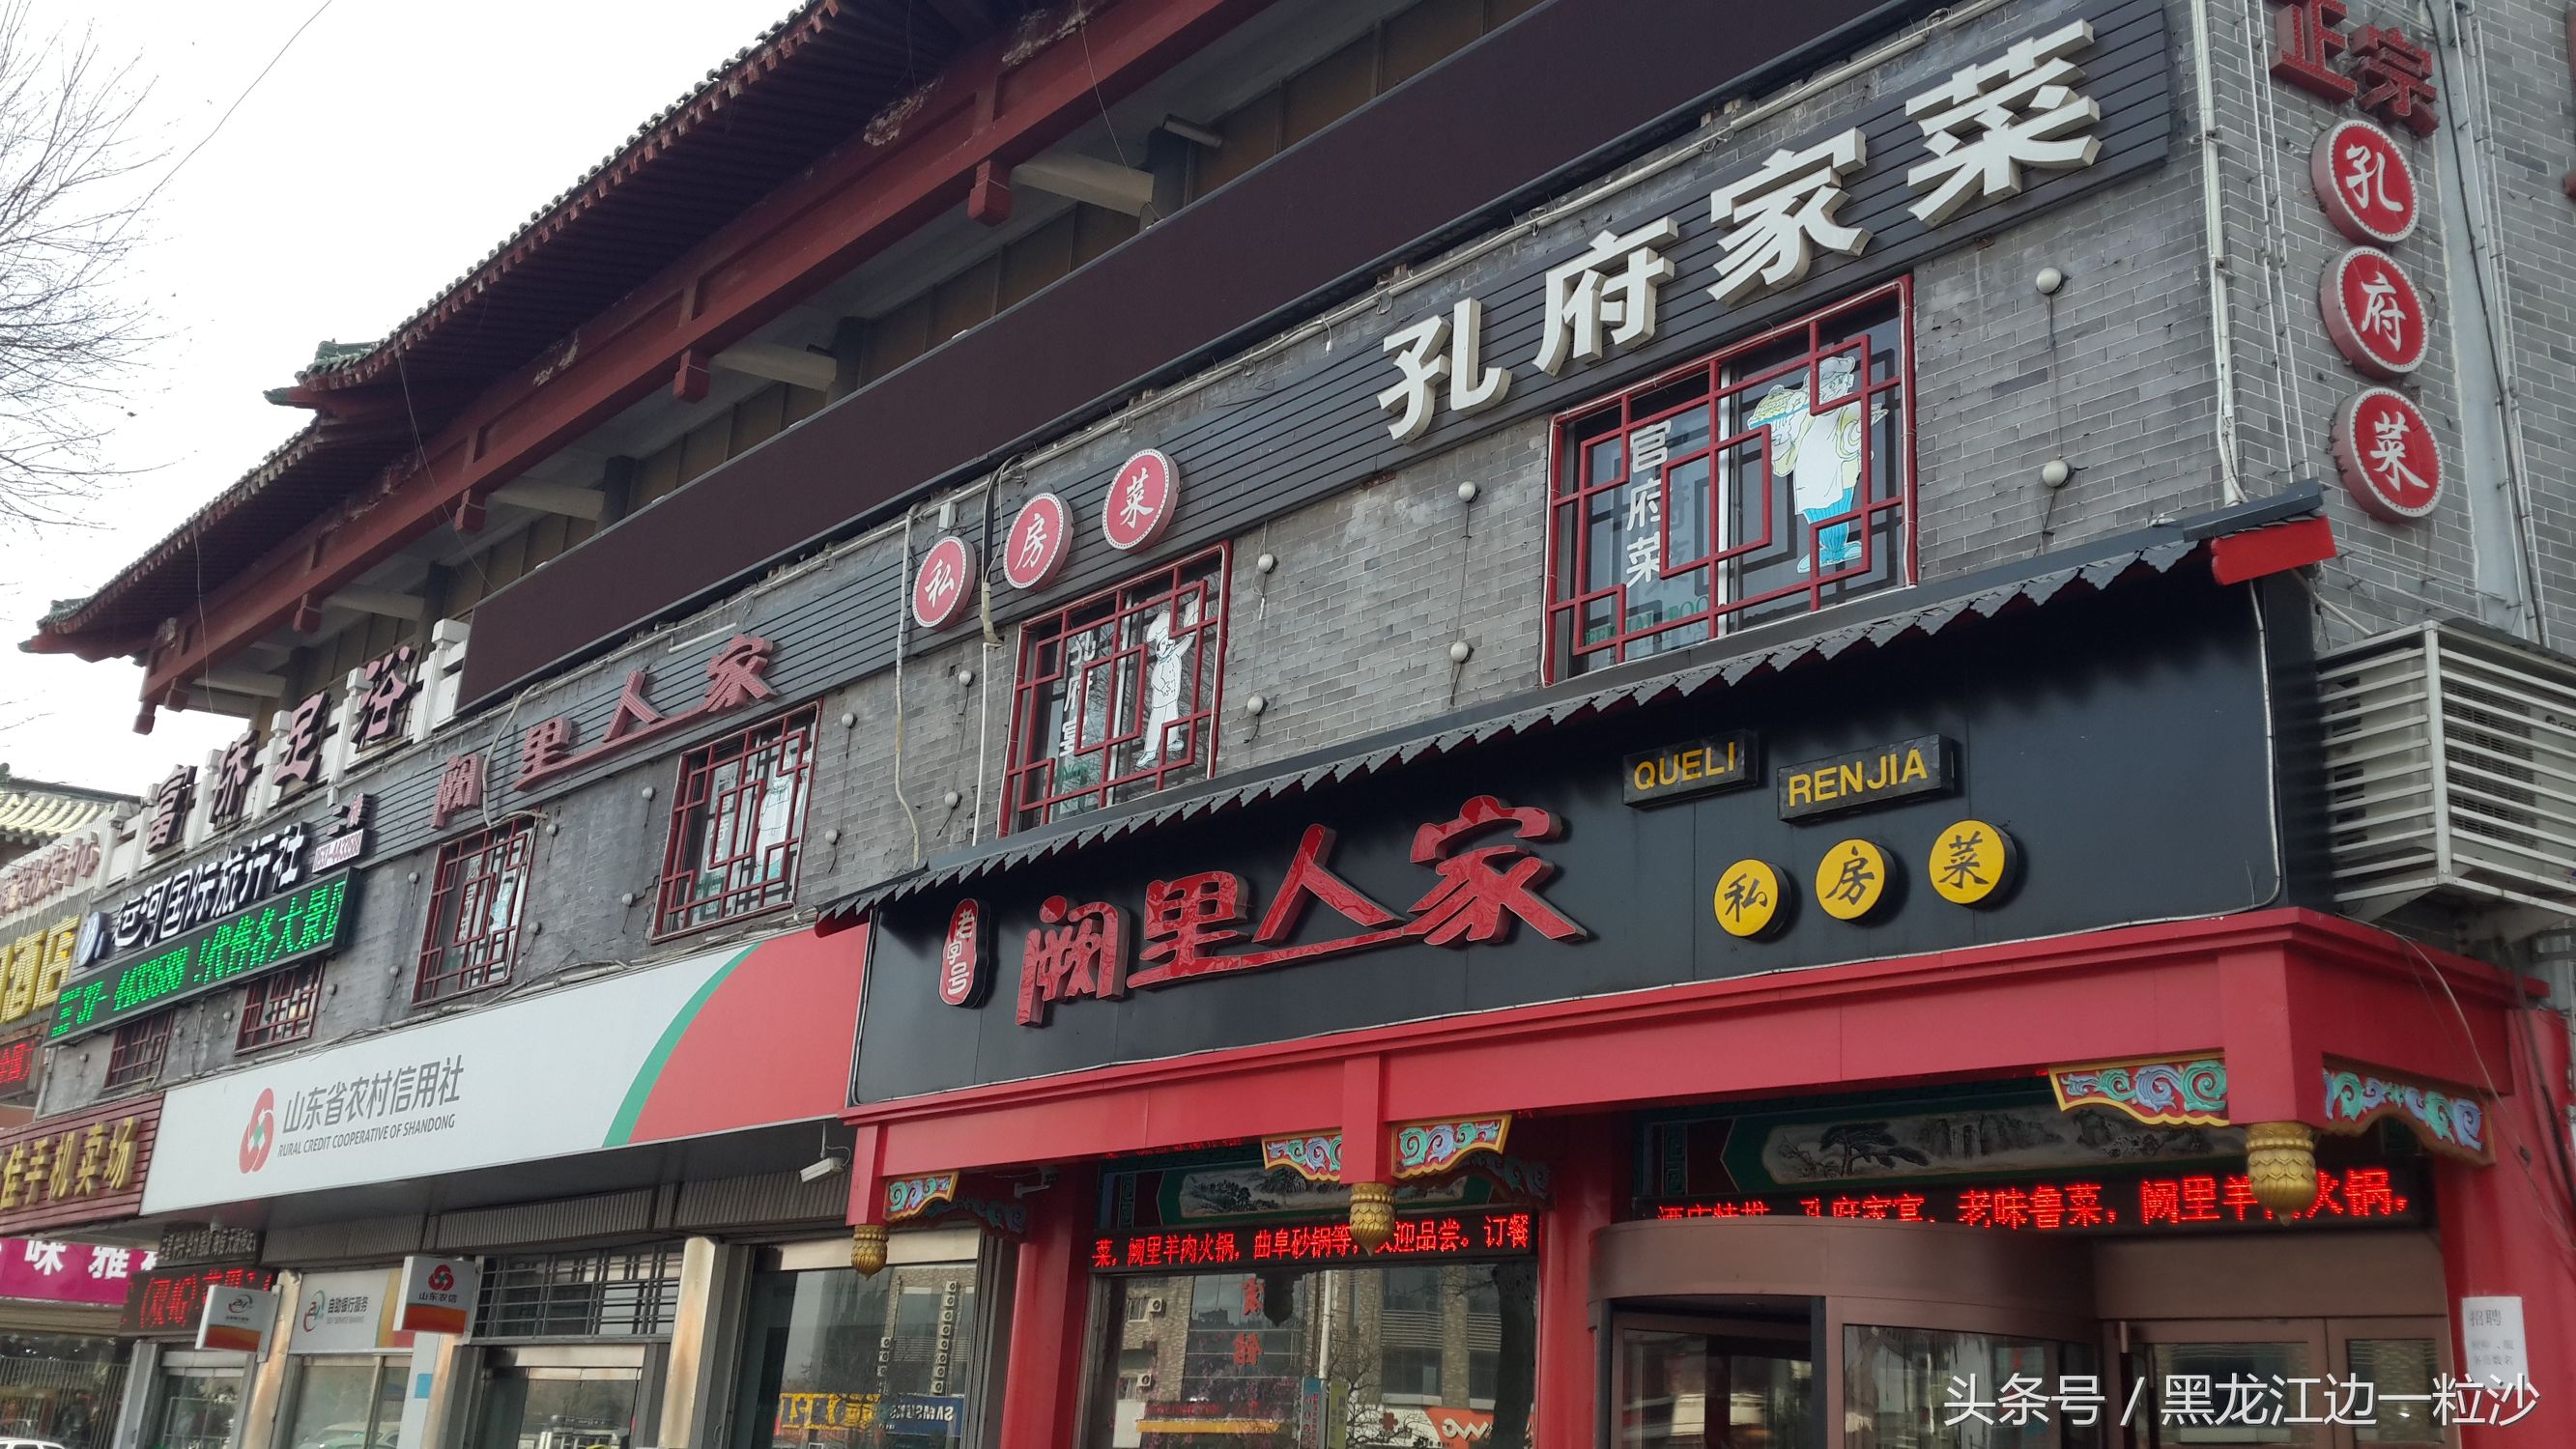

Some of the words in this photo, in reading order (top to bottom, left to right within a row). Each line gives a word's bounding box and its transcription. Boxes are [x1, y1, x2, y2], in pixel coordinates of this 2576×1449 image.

[2273, 0, 2439, 133] 正宗
[1378, 18, 2102, 443] 孔府家菜
[2344, 144, 2430, 491] 孔府菜
[924, 467, 1155, 609] 私房菜
[1626, 419, 1673, 588] 官府菜
[431, 633, 777, 829] 阙里人家
[1634, 742, 1736, 790] QUELI
[1789, 749, 1929, 808] RENJIA
[110, 821, 306, 949] 运河国际旅行社
[1016, 794, 1589, 1026] 阙里人家
[1723, 831, 1990, 923] 私房菜
[0, 913, 81, 1024] 酒店
[278, 1144, 302, 1157] RURAL
[303, 1136, 331, 1153] CREDIT
[332, 1126, 388, 1150] COOPERATIVE
[389, 1123, 402, 1139] OF
[402, 1114, 456, 1137] SHANDONG
[282, 1054, 465, 1134] 山东省农村信用社
[418, 1292, 458, 1303] 山东农信
